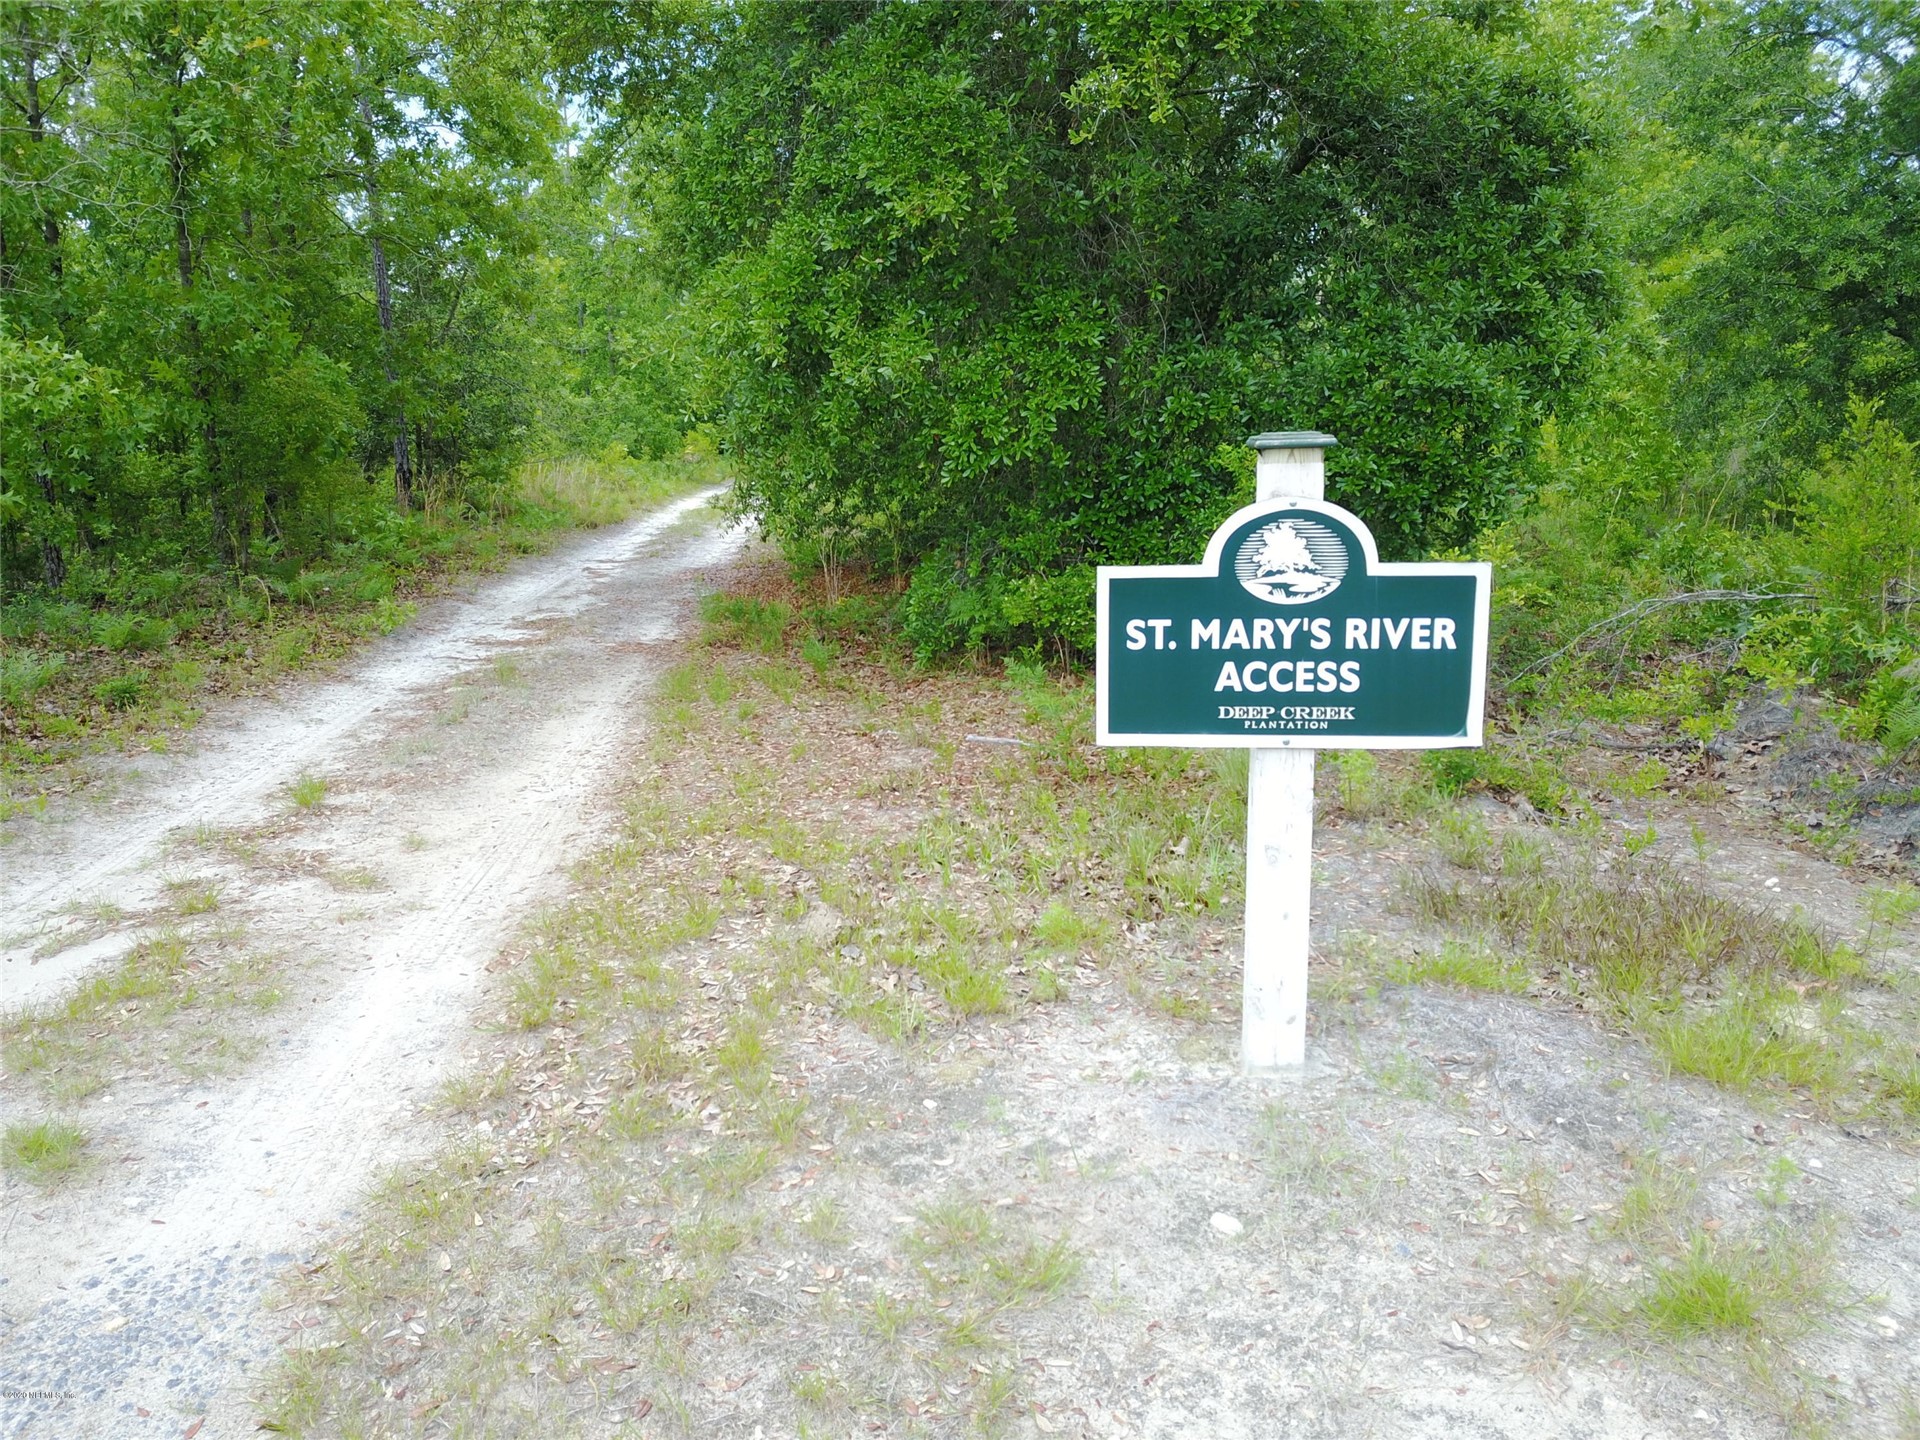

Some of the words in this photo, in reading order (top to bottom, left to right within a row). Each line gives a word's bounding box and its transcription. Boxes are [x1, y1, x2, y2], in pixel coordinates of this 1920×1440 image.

[1126, 618, 1177, 650] ST.
[1191, 618, 1332, 650] MARY'S
[1345, 617, 1457, 650] RIVER
[1214, 661, 1361, 693] ACCESS
[1218, 706, 1275, 719] DEEP
[1280, 706, 1356, 720] CREEK
[1244, 721, 1328, 729] PLANTATION
